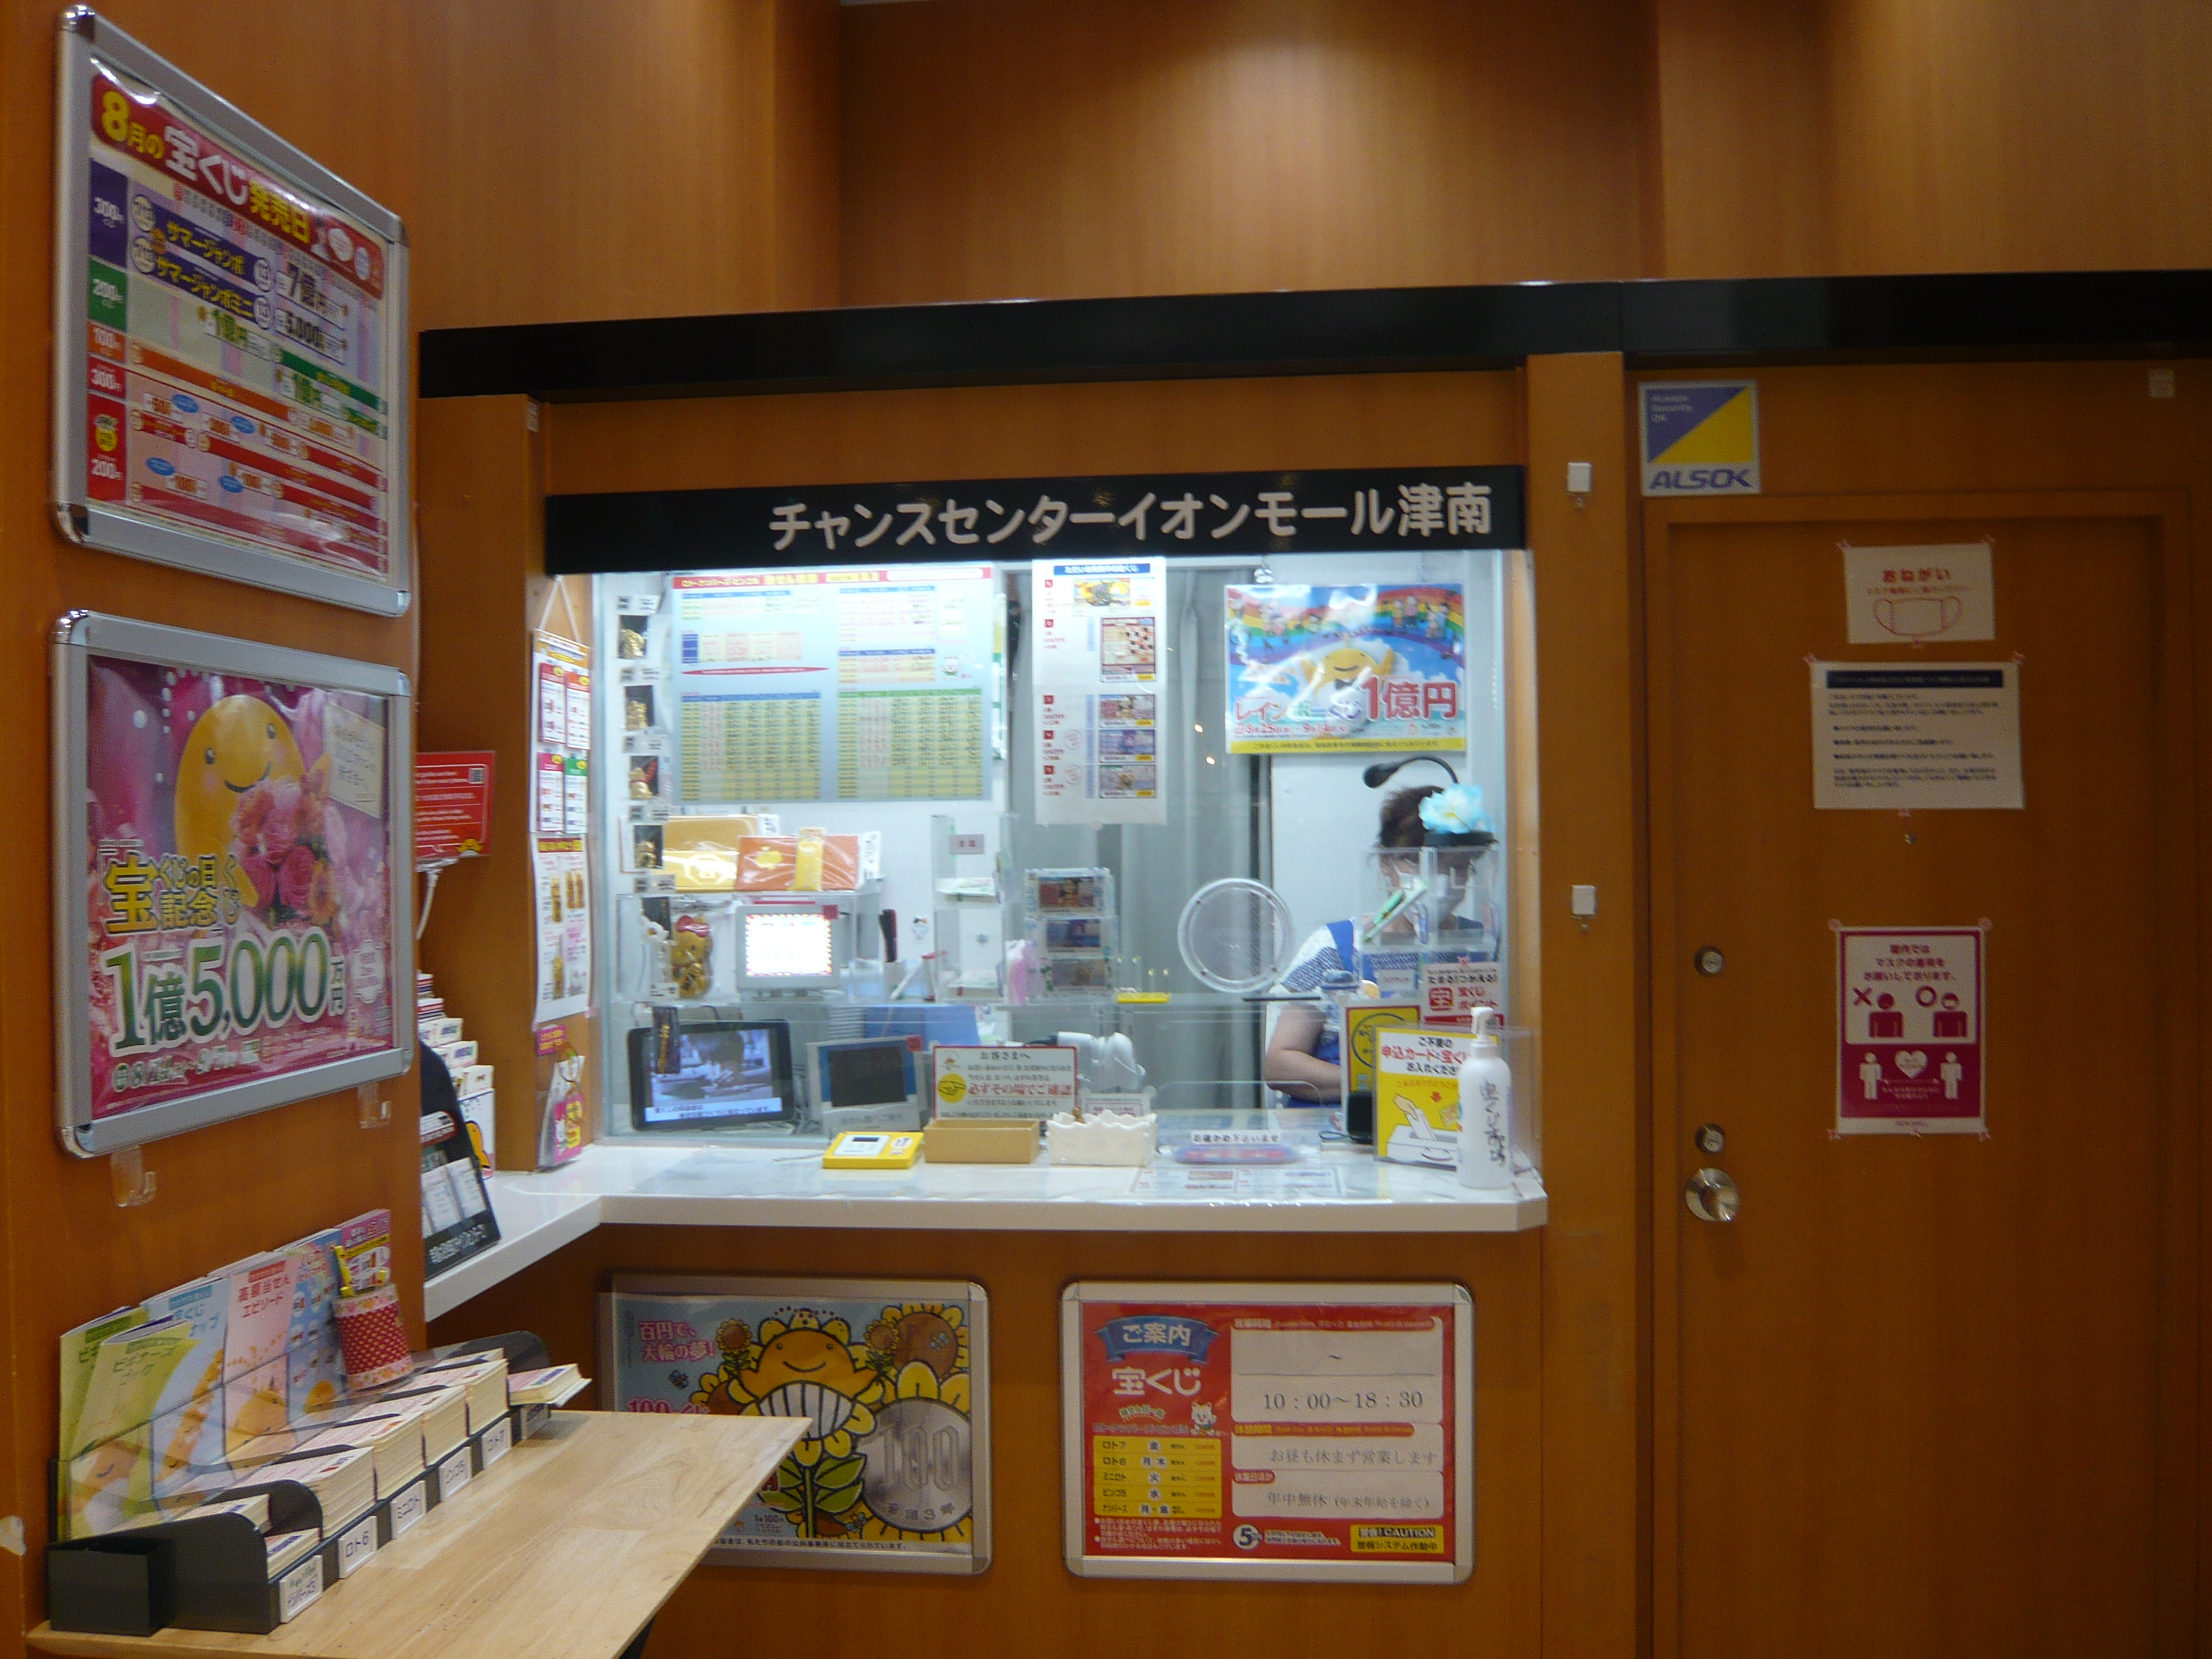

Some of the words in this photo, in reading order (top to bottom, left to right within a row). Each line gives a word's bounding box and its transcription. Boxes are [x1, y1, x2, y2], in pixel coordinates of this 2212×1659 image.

[1649, 468, 1753, 490] ALSOK
[769, 481, 1492, 551] チャンスセンターイオンモール津南
[1361, 675, 1459, 721] 1億円
[1122, 1322, 1192, 1347] ご案内
[642, 1340, 716, 1363] 大輪の夢!
[1111, 1365, 1202, 1396] 宝くじ
[1102, 1441, 1127, 1449] ロト7
[1269, 1447, 1438, 1465] お昼も休まず営業します
[880, 1424, 961, 1493] 100
[1102, 1457, 1127, 1466] ロト6
[1267, 1492, 1327, 1508] 年中無休
[345, 1529, 371, 1559] ロト6
[1384, 1527, 1435, 1538] CAUTION
